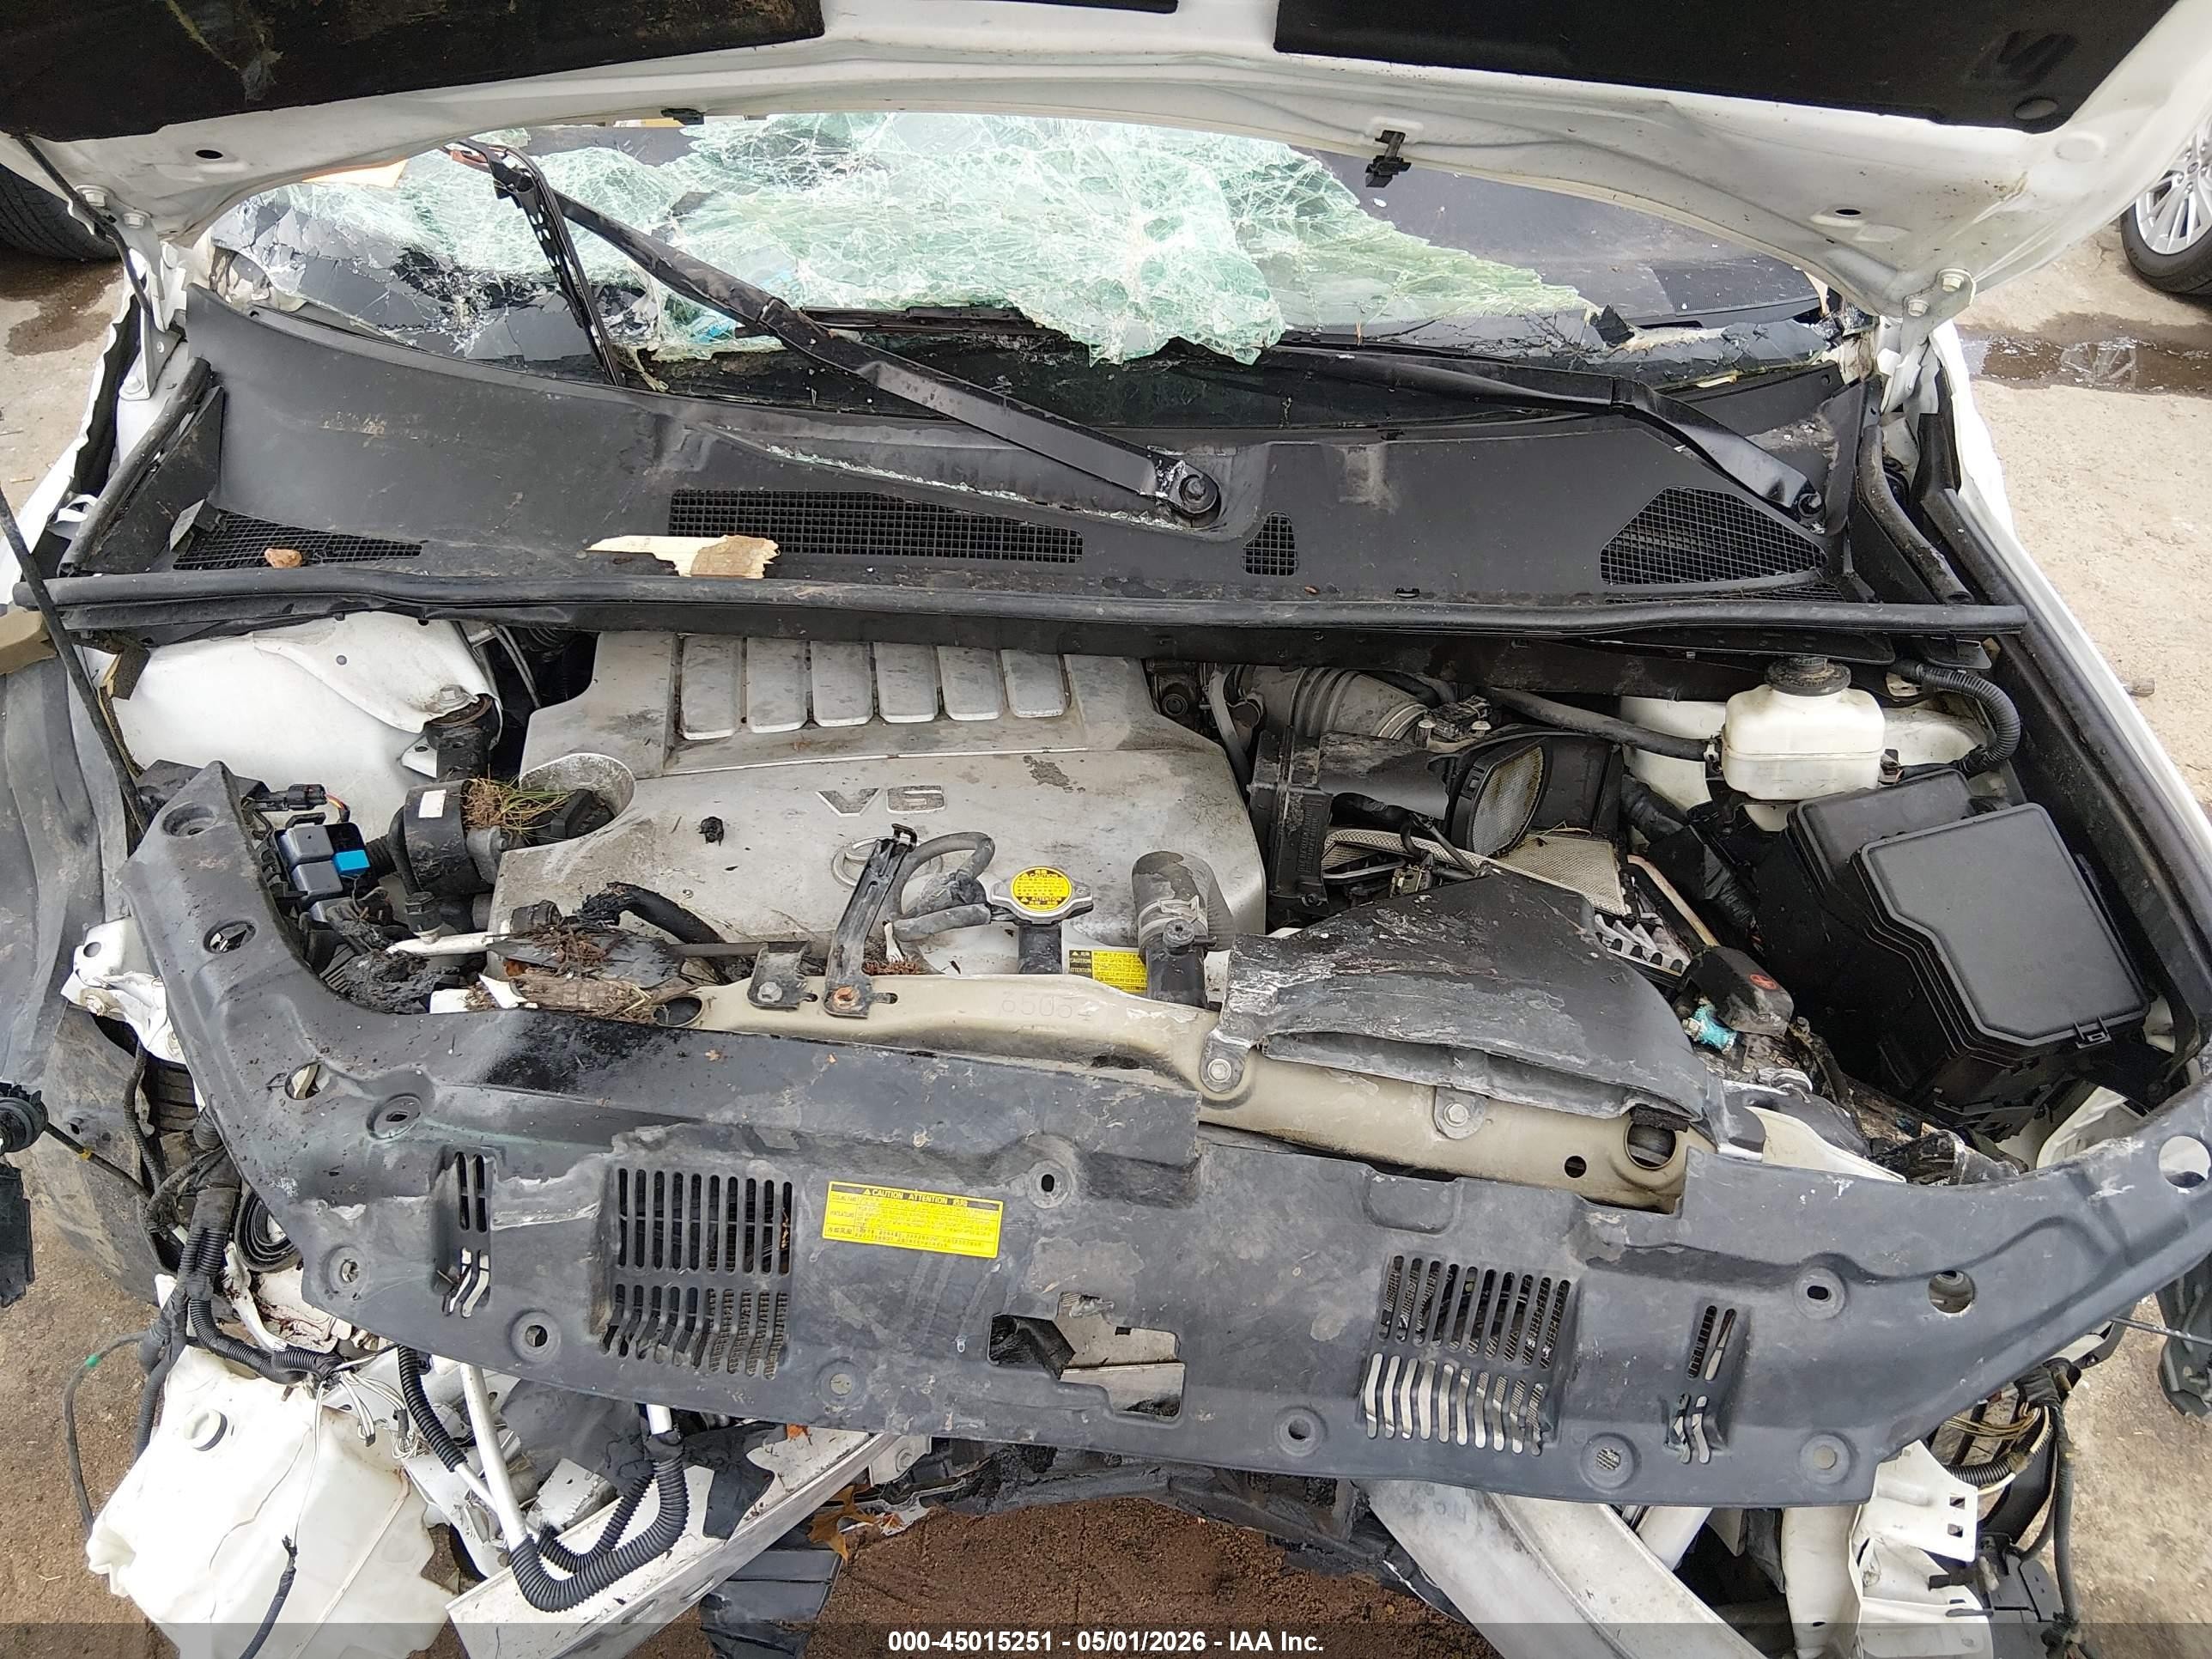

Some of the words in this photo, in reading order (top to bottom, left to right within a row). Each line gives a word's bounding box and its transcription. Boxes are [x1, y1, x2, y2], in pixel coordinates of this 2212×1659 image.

[815, 785, 946, 817] V6
[872, 1188, 904, 1200] CAUTION
[908, 1194, 948, 1205] ATTENTION
